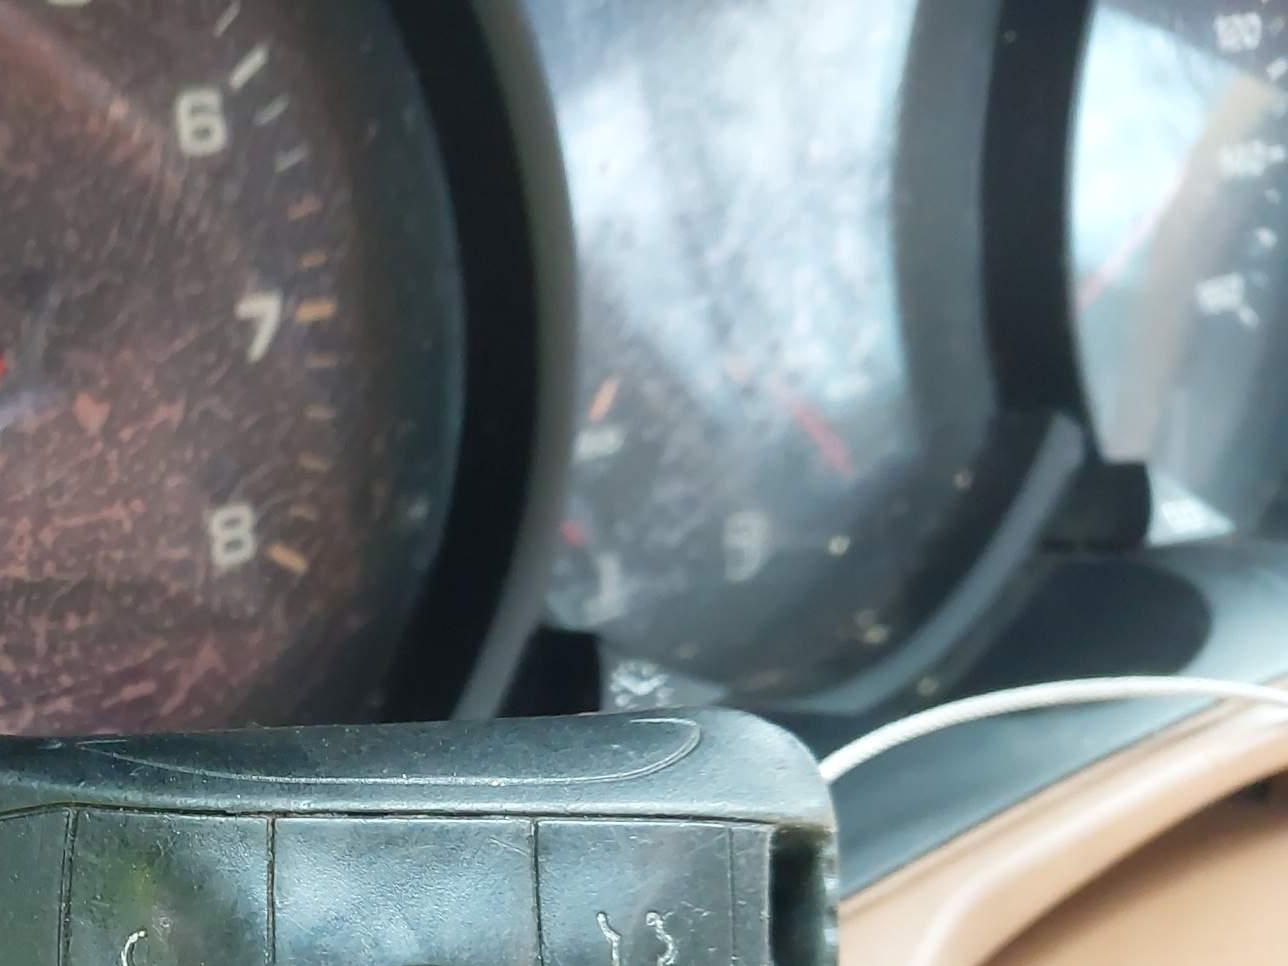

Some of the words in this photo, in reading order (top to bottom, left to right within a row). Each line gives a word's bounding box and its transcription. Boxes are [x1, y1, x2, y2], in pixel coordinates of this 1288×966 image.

[174, 88, 228, 157] 6
[234, 289, 284, 364] 7
[209, 503, 255, 569] 8
